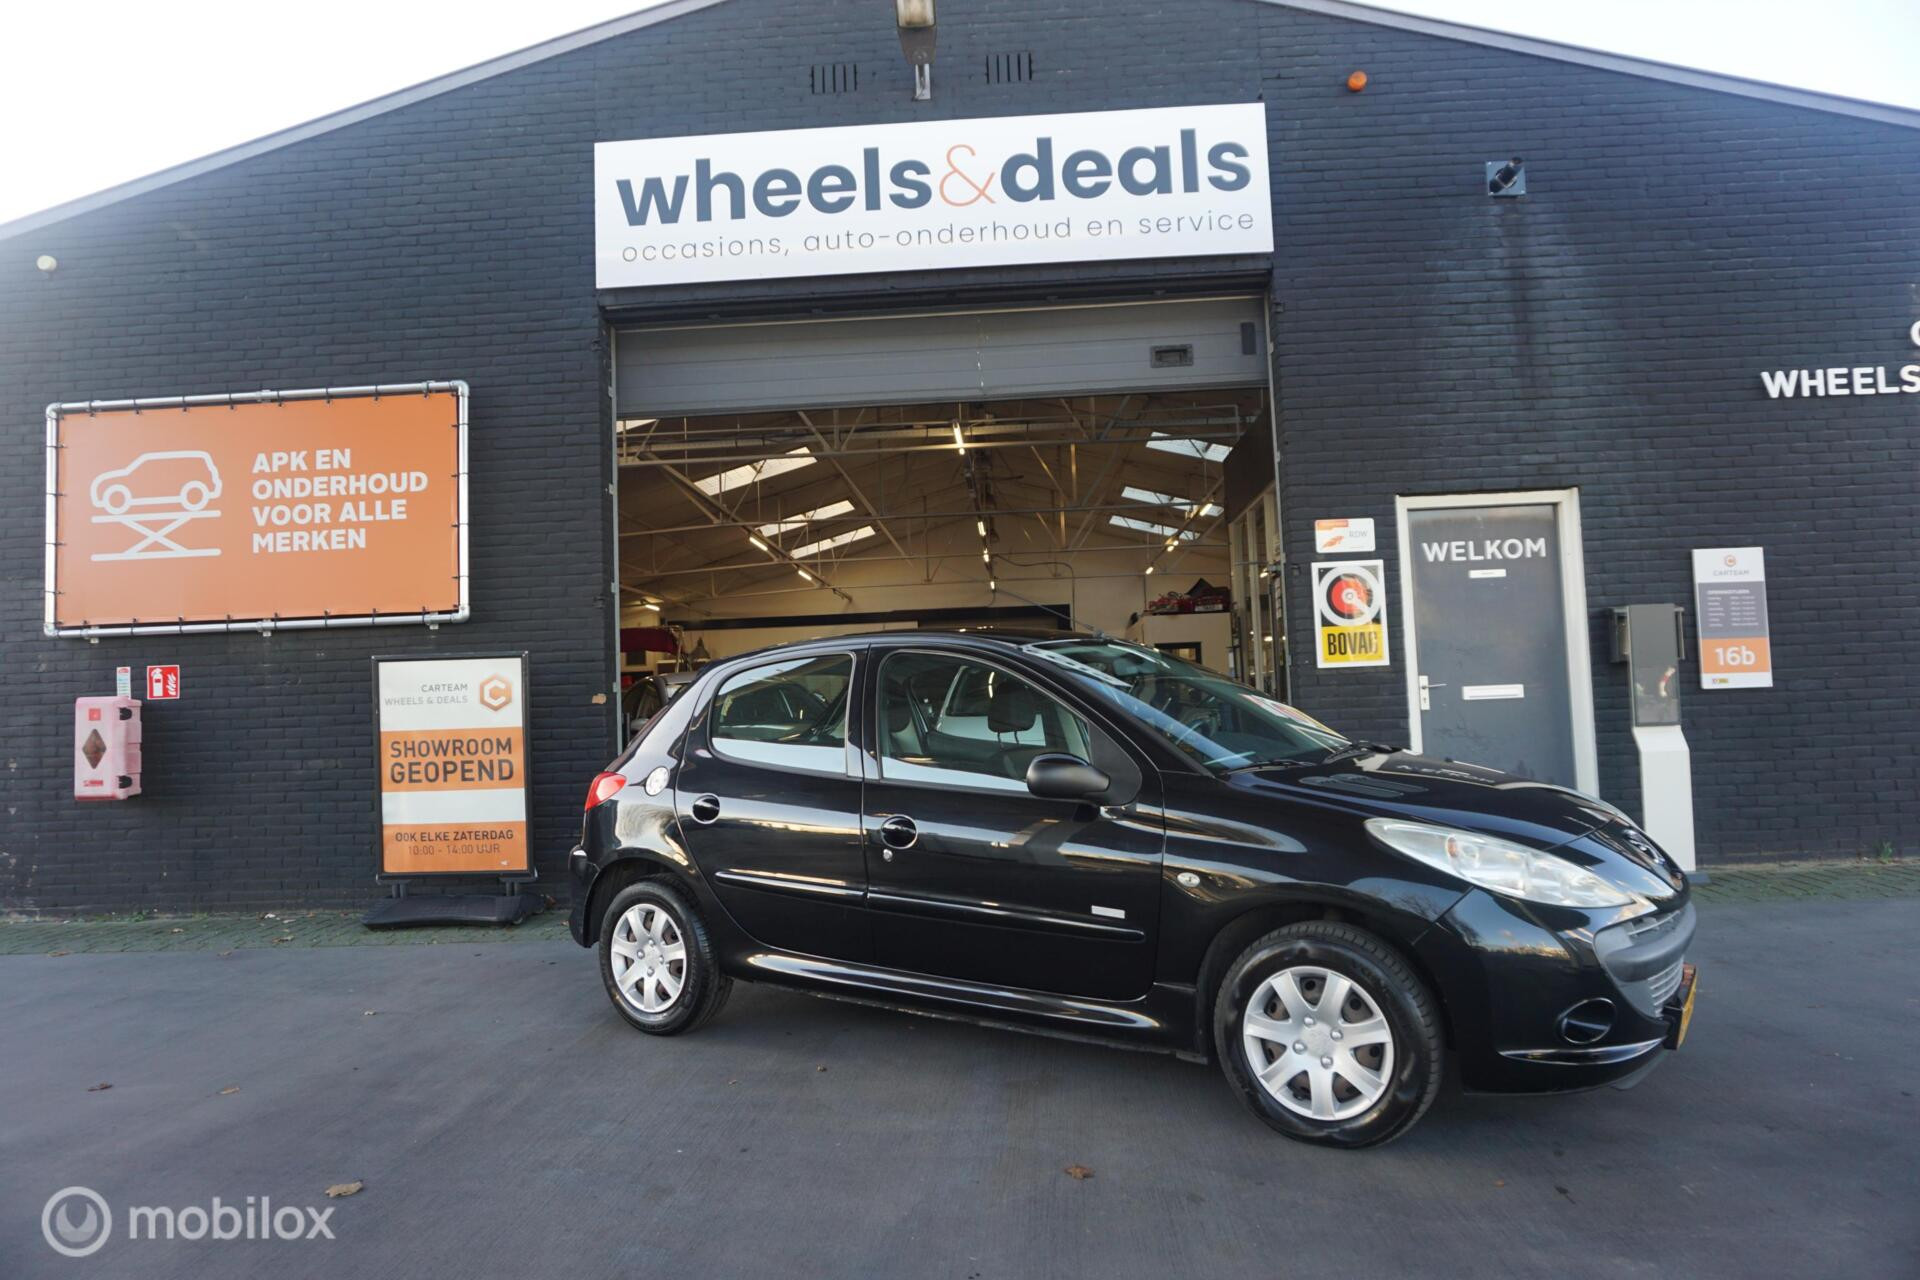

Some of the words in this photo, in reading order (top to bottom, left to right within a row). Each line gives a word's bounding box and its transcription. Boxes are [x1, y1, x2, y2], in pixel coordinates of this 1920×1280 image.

[616, 128, 1252, 227] wheels&deals
[622, 232, 789, 263] occasions,
[803, 216, 1072, 253] auto-onderhoud
[1086, 217, 1124, 237] en
[1138, 210, 1254, 235] service
[1760, 364, 1920, 399] WHEELS
[252, 450, 308, 474] APK
[315, 448, 351, 470] EN
[252, 471, 428, 500] ONDERHOUD
[252, 503, 332, 527] VOOR
[338, 499, 407, 522] ALLE
[252, 528, 366, 554] MERKEN
[1422, 537, 1547, 562] WELKOM
[1715, 645, 1756, 666] 16b
[385, 696, 424, 706] WHEELS
[437, 695, 468, 704] DEALS
[421, 683, 468, 693] CARTEAM
[390, 737, 513, 758] SHOWROOM
[390, 759, 514, 783] GEOPEND
[395, 832, 417, 842] OOK
[420, 831, 450, 842] ELKE
[453, 829, 514, 840] ZATERDAG
[476, 843, 501, 854] UUR
